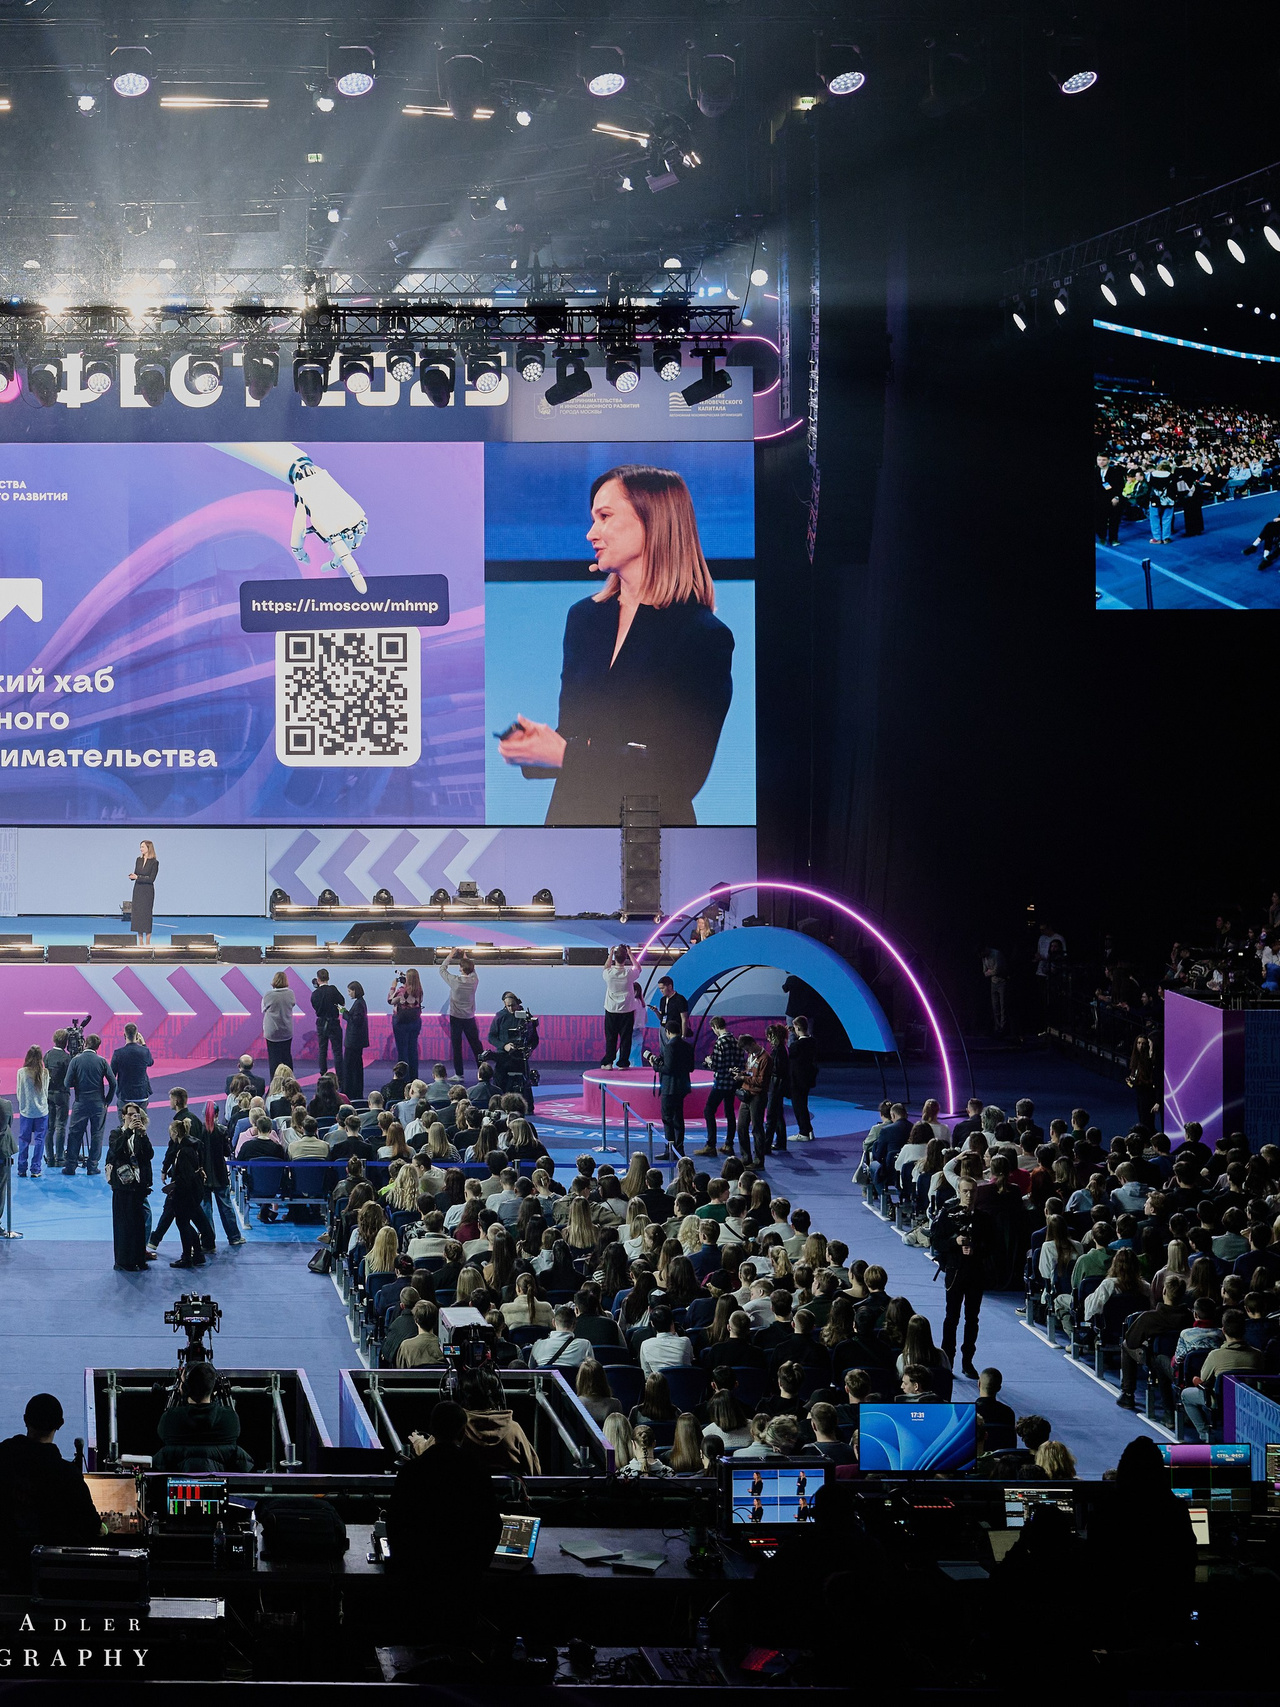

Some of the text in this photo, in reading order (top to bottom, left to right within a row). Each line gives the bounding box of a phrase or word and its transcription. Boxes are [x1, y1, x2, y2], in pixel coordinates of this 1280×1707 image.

[12, 492, 68, 501] РАЗВИТИЯ
[252, 597, 439, 616] https://i.moscow/mhmp
[53, 666, 115, 693] хаб
